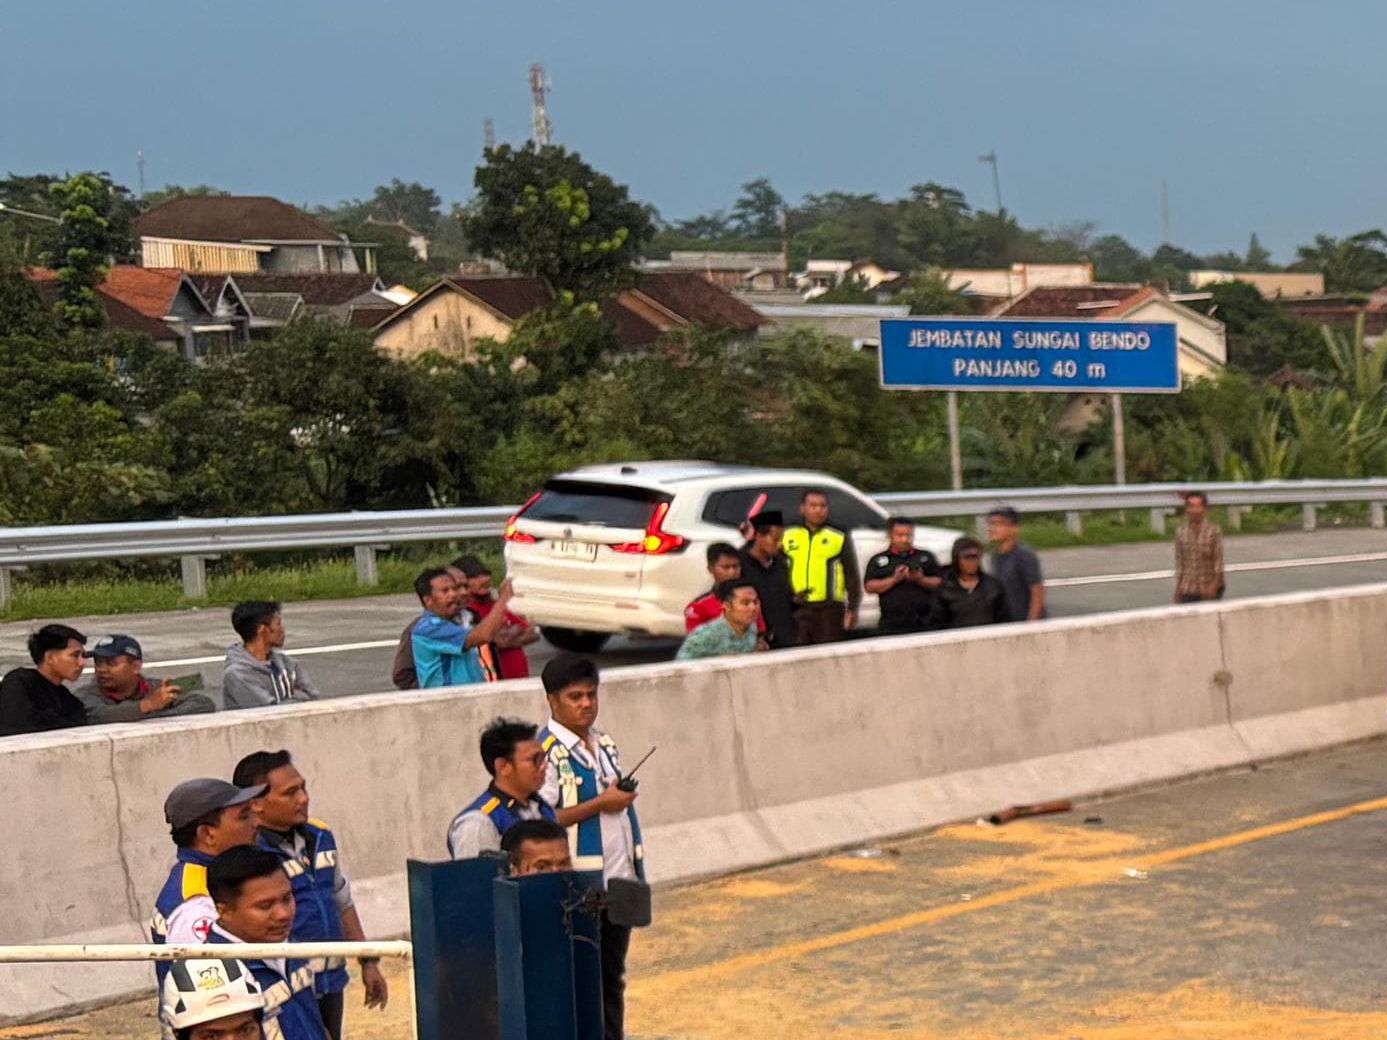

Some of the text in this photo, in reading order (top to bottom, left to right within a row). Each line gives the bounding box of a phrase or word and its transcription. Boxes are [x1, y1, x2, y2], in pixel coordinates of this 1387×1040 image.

[908, 329, 1150, 350] JEMBATAN SUNGAI BENDO
[953, 358, 1106, 378] PANJANG 40 m
